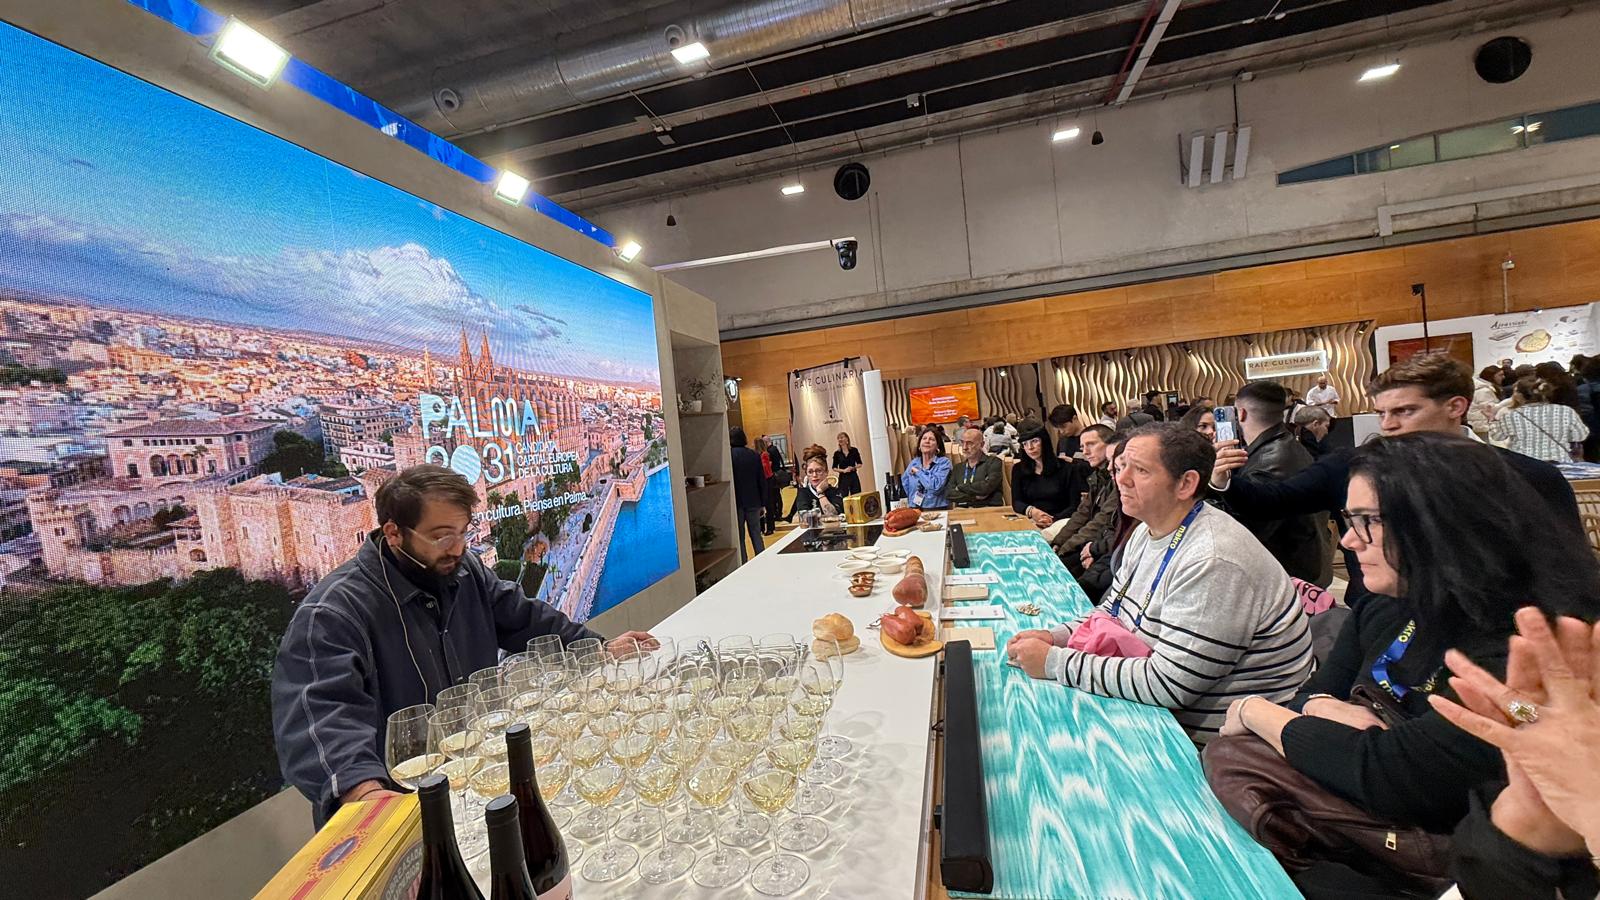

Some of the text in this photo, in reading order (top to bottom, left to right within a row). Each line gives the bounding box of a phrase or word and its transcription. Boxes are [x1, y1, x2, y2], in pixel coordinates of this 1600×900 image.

[1272, 356, 1321, 367] CULINARIA
[815, 368, 864, 385] CULINARIA
[419, 394, 540, 438] PALMA
[516, 440, 558, 455] CANDIDATA
[425, 442, 515, 485] 2031
[516, 451, 579, 466] CAPITAL EUROPEA
[518, 462, 574, 479] DE LA CULTURA
[485, 503, 523, 521] cultura.
[524, 497, 554, 513] Piensa
[553, 495, 564, 507] en
[1169, 525, 1187, 549] makro
[1398, 619, 1417, 643] akro
